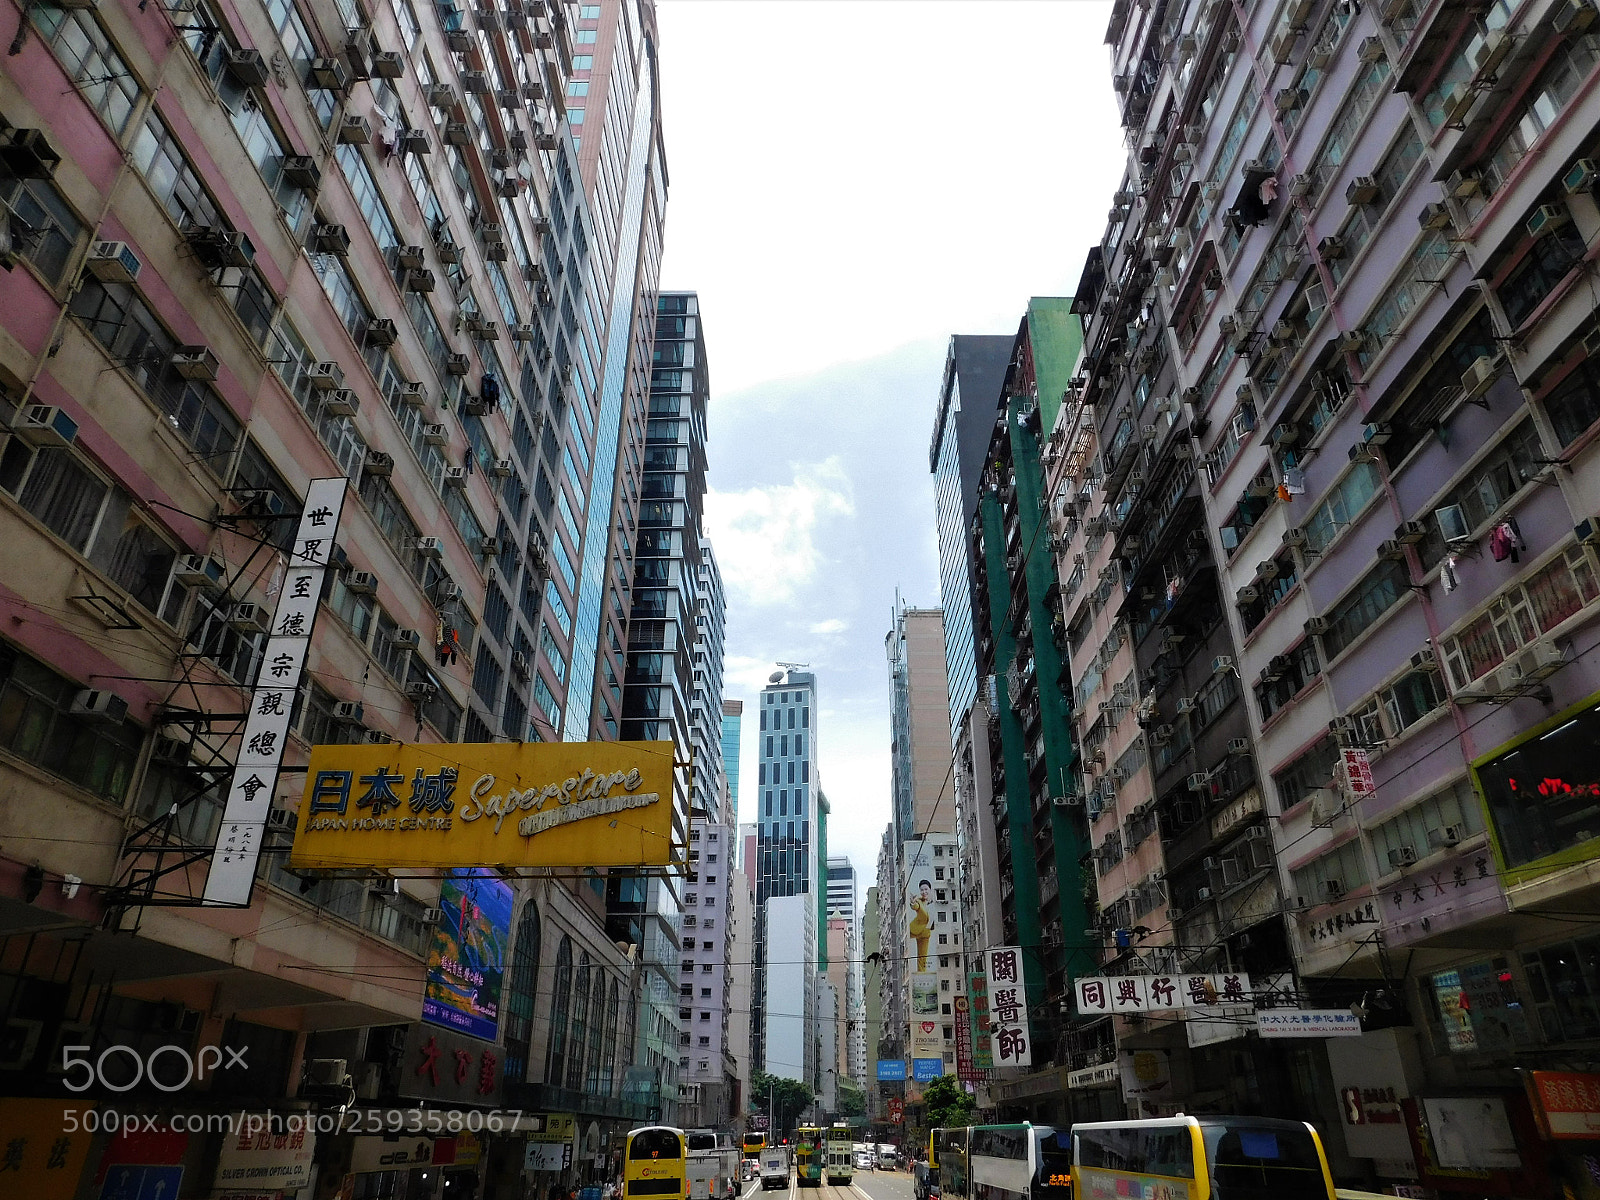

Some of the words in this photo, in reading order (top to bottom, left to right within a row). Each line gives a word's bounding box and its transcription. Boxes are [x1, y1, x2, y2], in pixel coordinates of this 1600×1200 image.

[236, 505, 334, 802] 世界至德宗親總會
[308, 766, 460, 816] 日本城
[460, 766, 644, 835] Superstore
[305, 818, 349, 833] JAPAN
[351, 817, 396, 831] HOME
[399, 816, 453, 831] CENTRE
[222, 1168, 244, 1181] SILVER
[246, 1167, 268, 1180] CROWN
[269, 1166, 292, 1178] OPTICAL
